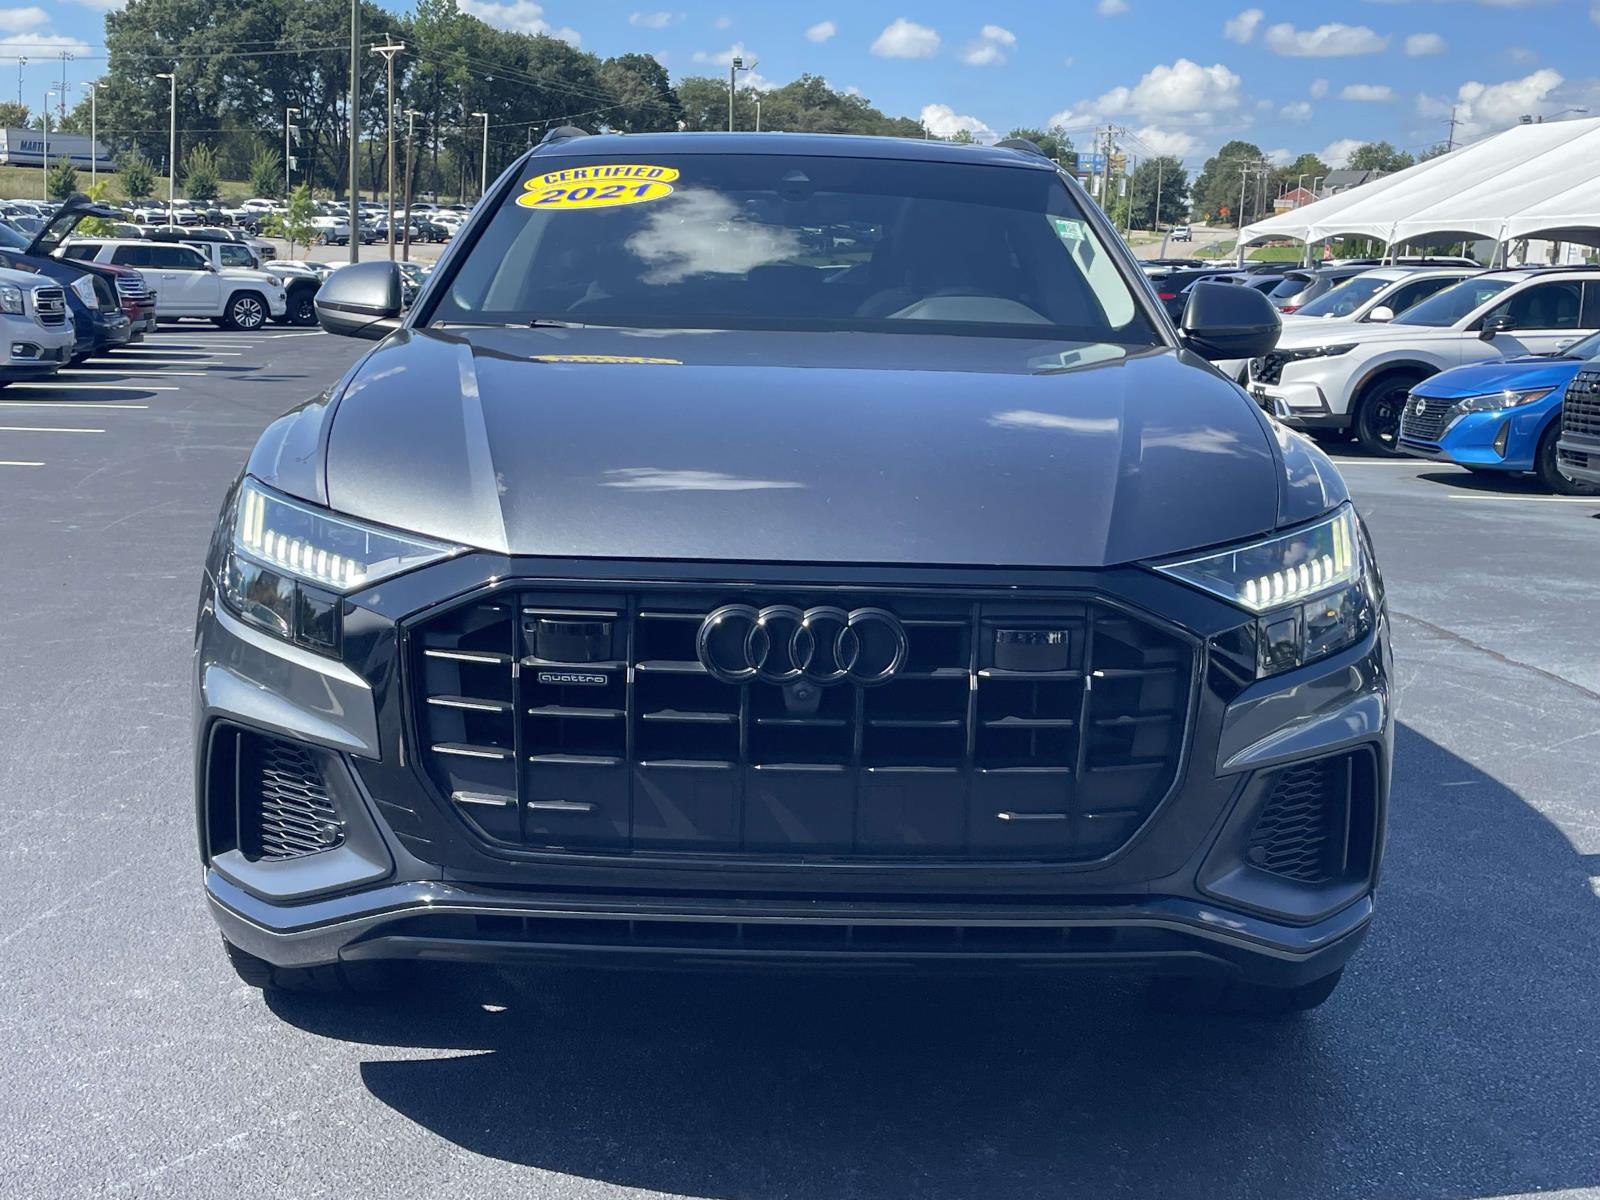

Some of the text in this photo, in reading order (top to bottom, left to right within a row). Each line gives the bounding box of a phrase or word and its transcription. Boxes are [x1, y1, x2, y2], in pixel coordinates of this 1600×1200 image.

[543, 166, 664, 185] CERTIFIED
[534, 183, 654, 205] 2021
[541, 674, 604, 682] quattro
